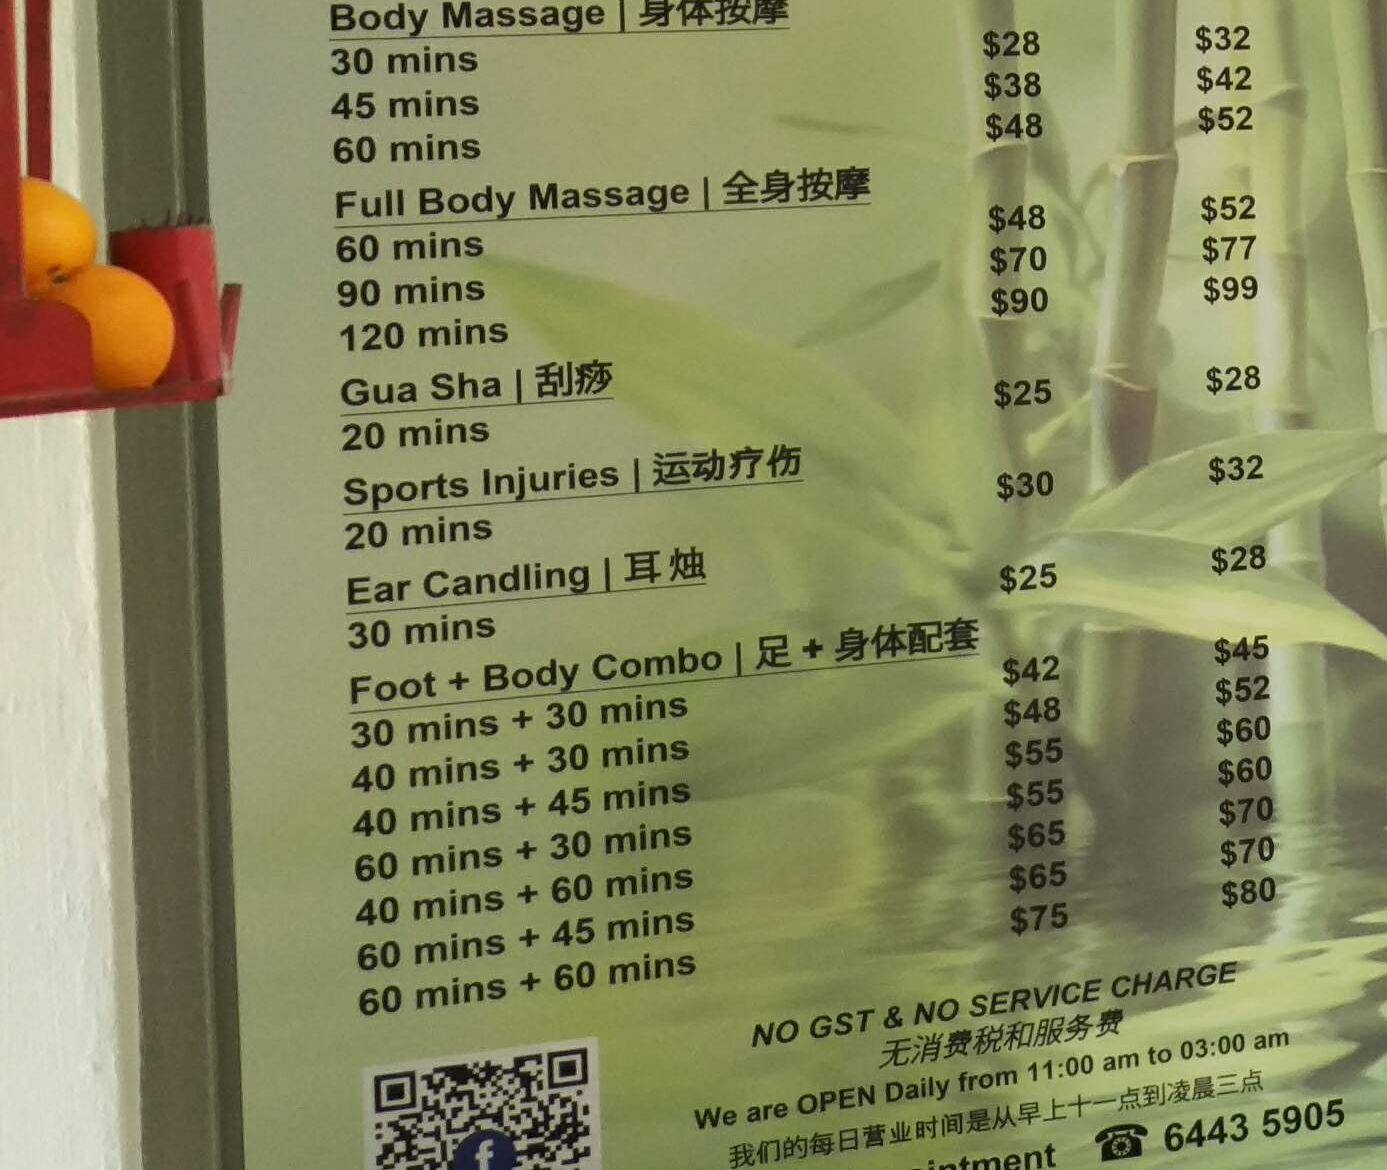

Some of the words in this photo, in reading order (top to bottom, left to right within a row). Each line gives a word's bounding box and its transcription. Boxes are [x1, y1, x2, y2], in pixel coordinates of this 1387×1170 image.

[330, 3, 430, 39] Body
[443, 2, 604, 35] Massage
[983, 30, 1040, 60] $28
[1196, 25, 1250, 54] $32
[331, 48, 373, 75] 30
[388, 46, 478, 74] mins
[985, 72, 1041, 101] $38
[1197, 66, 1251, 94] $42
[331, 92, 375, 119] 45
[389, 90, 479, 118] mins
[1198, 106, 1252, 134] $52
[986, 113, 1042, 142] $48
[334, 136, 376, 164] 60
[391, 134, 480, 162] mins
[336, 189, 404, 218] Full
[420, 186, 517, 221] Body
[527, 183, 692, 214] Massage
[723, 166, 870, 204] 全身按摩
[1201, 195, 1256, 224] $52
[989, 204, 1045, 235] $48
[336, 235, 379, 263] 60
[394, 232, 483, 260] mins
[990, 246, 1046, 276] $70
[1203, 236, 1256, 265] $77
[338, 280, 380, 307] 90
[395, 276, 485, 304] mins
[992, 287, 1048, 317] $90
[1204, 276, 1258, 304] $99
[340, 322, 404, 351] 120
[419, 318, 508, 347] mins
[341, 379, 417, 406] Gua
[431, 373, 501, 400] Sha
[535, 360, 612, 398] 刮痧
[994, 379, 1051, 410] $25
[1207, 365, 1260, 395] $28
[342, 422, 384, 451] 20
[400, 418, 489, 447] mins
[344, 474, 470, 515] Sports
[481, 463, 619, 499] Injuries
[653, 444, 801, 486] 运动疗伤
[1209, 455, 1263, 485] $32
[997, 471, 1053, 502] $30
[345, 521, 387, 550] 20
[403, 516, 492, 545] mins
[348, 577, 411, 605] Ear
[421, 563, 592, 601] Candling
[624, 547, 706, 583] 耳烛
[1212, 544, 1266, 576] $28
[1000, 563, 1057, 594] $25
[349, 620, 390, 649] 30
[406, 615, 495, 644] mins
[351, 672, 436, 704] Foot
[482, 660, 581, 696] Body
[593, 647, 722, 680] Combo
[756, 635, 792, 670] 足
[835, 617, 979, 665] 身体配套
[1215, 635, 1269, 666] $45
[1002, 655, 1059, 687] $42
[352, 719, 393, 748] 30
[408, 713, 498, 743] mins
[547, 701, 587, 729] 30
[601, 695, 687, 724] mins
[1217, 716, 1270, 747] $60
[1006, 737, 1063, 769] $55
[353, 808, 396, 837] 40
[411, 801, 501, 831] mins
[549, 787, 590, 815] 45
[604, 781, 690, 811] mins
[1219, 796, 1276, 828] $70
[1008, 820, 1065, 853] $65
[356, 897, 399, 926] 40
[414, 889, 504, 920] mins
[552, 874, 592, 903] 60
[607, 867, 693, 897] mins
[1222, 877, 1276, 909] $80
[1011, 902, 1068, 936] $75
[359, 985, 401, 1016] 60
[416, 977, 506, 1009] mins
[555, 961, 595, 991] 60
[609, 953, 696, 984] mins
[752, 1020, 798, 1047] NO
[810, 1009, 875, 1038] GST
[884, 1006, 903, 1029] &
[914, 999, 959, 1025] NO
[969, 979, 1102, 1017] SERVICE
[1112, 961, 1239, 998] CHARGE
[879, 1006, 1126, 1073] 无消费税和服务费
[694, 1107, 737, 1129] We
[747, 1103, 788, 1122] are
[798, 1085, 875, 1114] OPEN
[886, 1077, 950, 1102] Daily
[958, 1070, 1017, 1092] from
[1028, 1055, 1093, 1081] 11:00
[1103, 1053, 1139, 1071] am
[1148, 1047, 1172, 1065] to
[1181, 1033, 1245, 1060] 03:00
[1254, 1032, 1289, 1050] am
[1165, 1114, 1248, 1151] 6443
[1263, 1099, 1344, 1137] 5905
